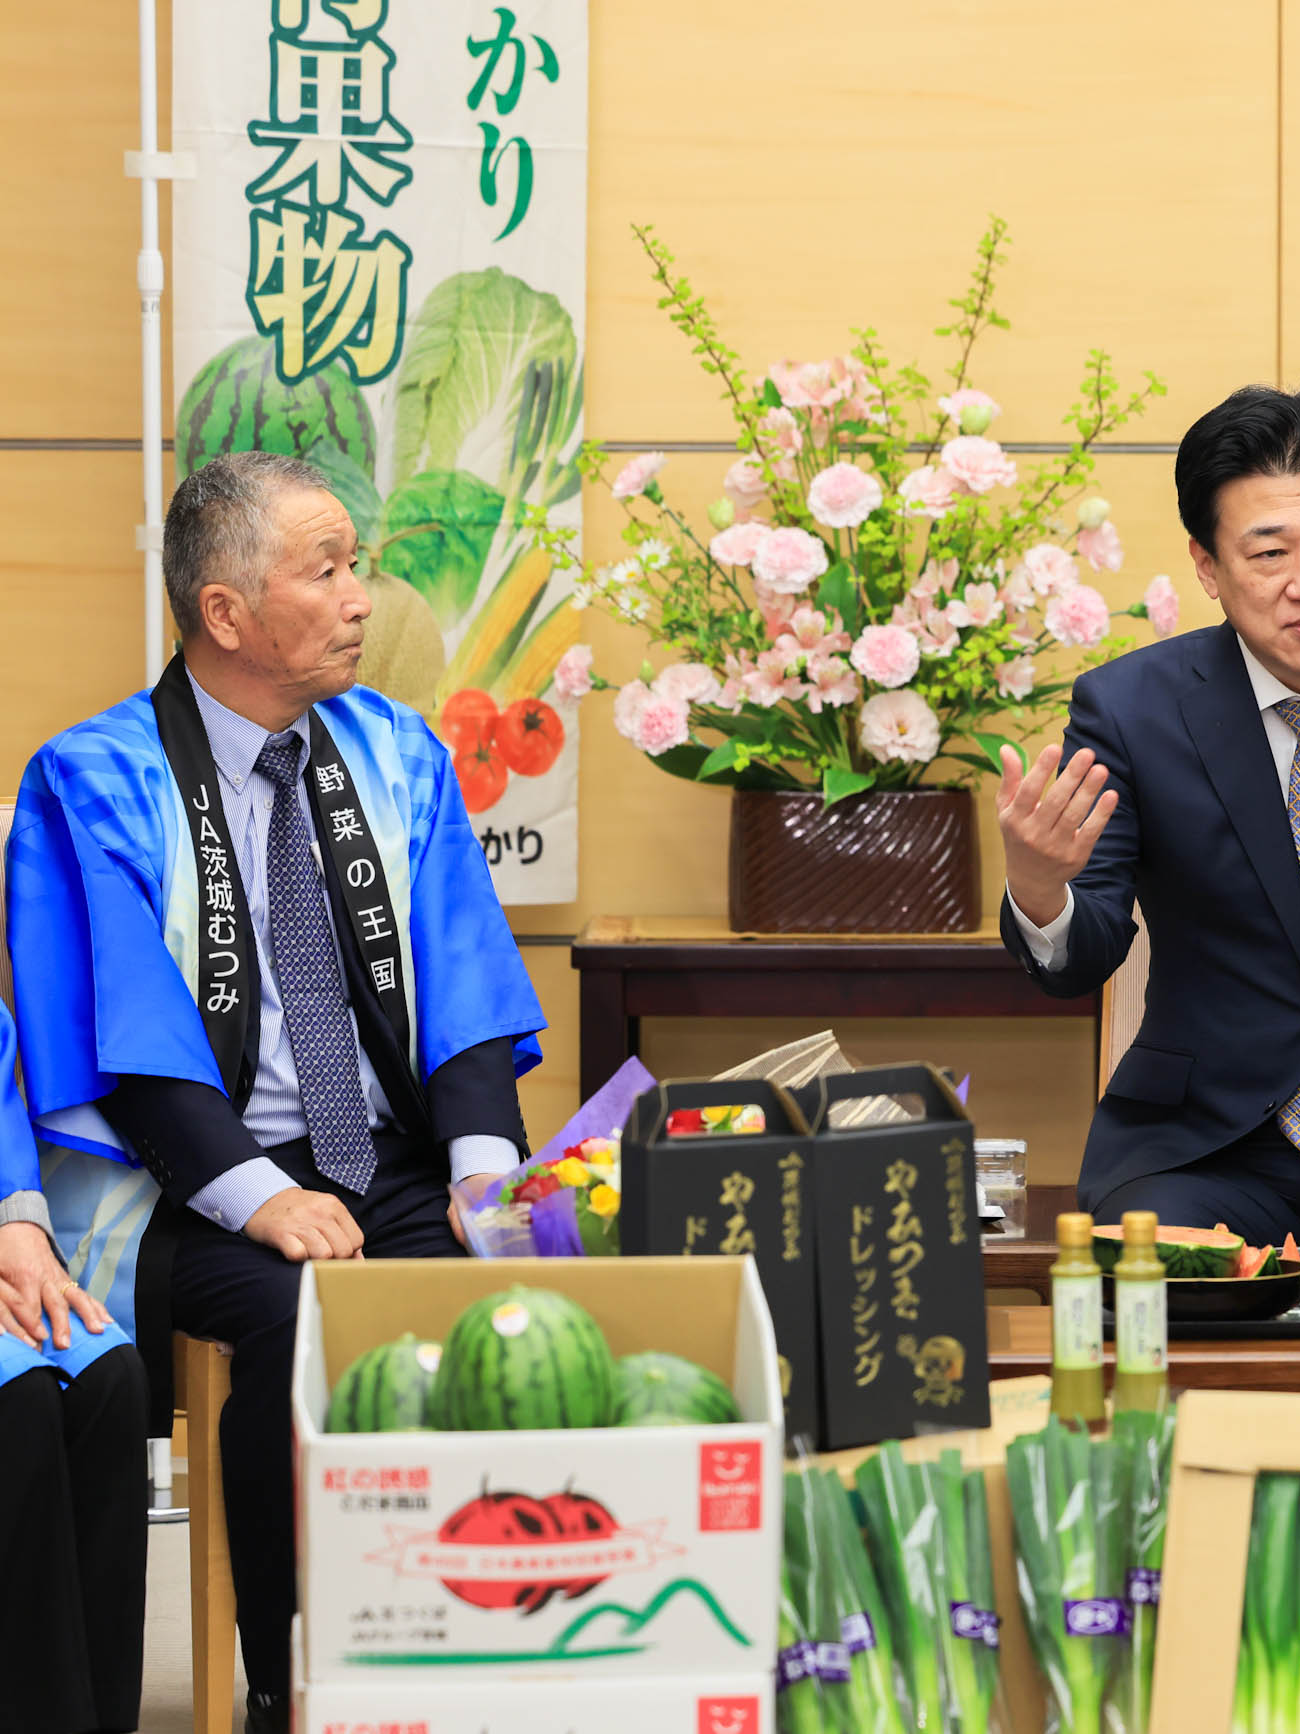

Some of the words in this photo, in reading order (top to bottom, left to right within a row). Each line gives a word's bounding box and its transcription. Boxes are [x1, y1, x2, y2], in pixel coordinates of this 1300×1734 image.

[467, 8, 560, 242] かり
[193, 784, 240, 1014] JA茨城むつみ
[316, 763, 397, 993] 野菜の王国
[480, 826, 543, 865] かり
[683, 1216, 708, 1255] ド
[849, 1205, 884, 1388] ドレッシング
